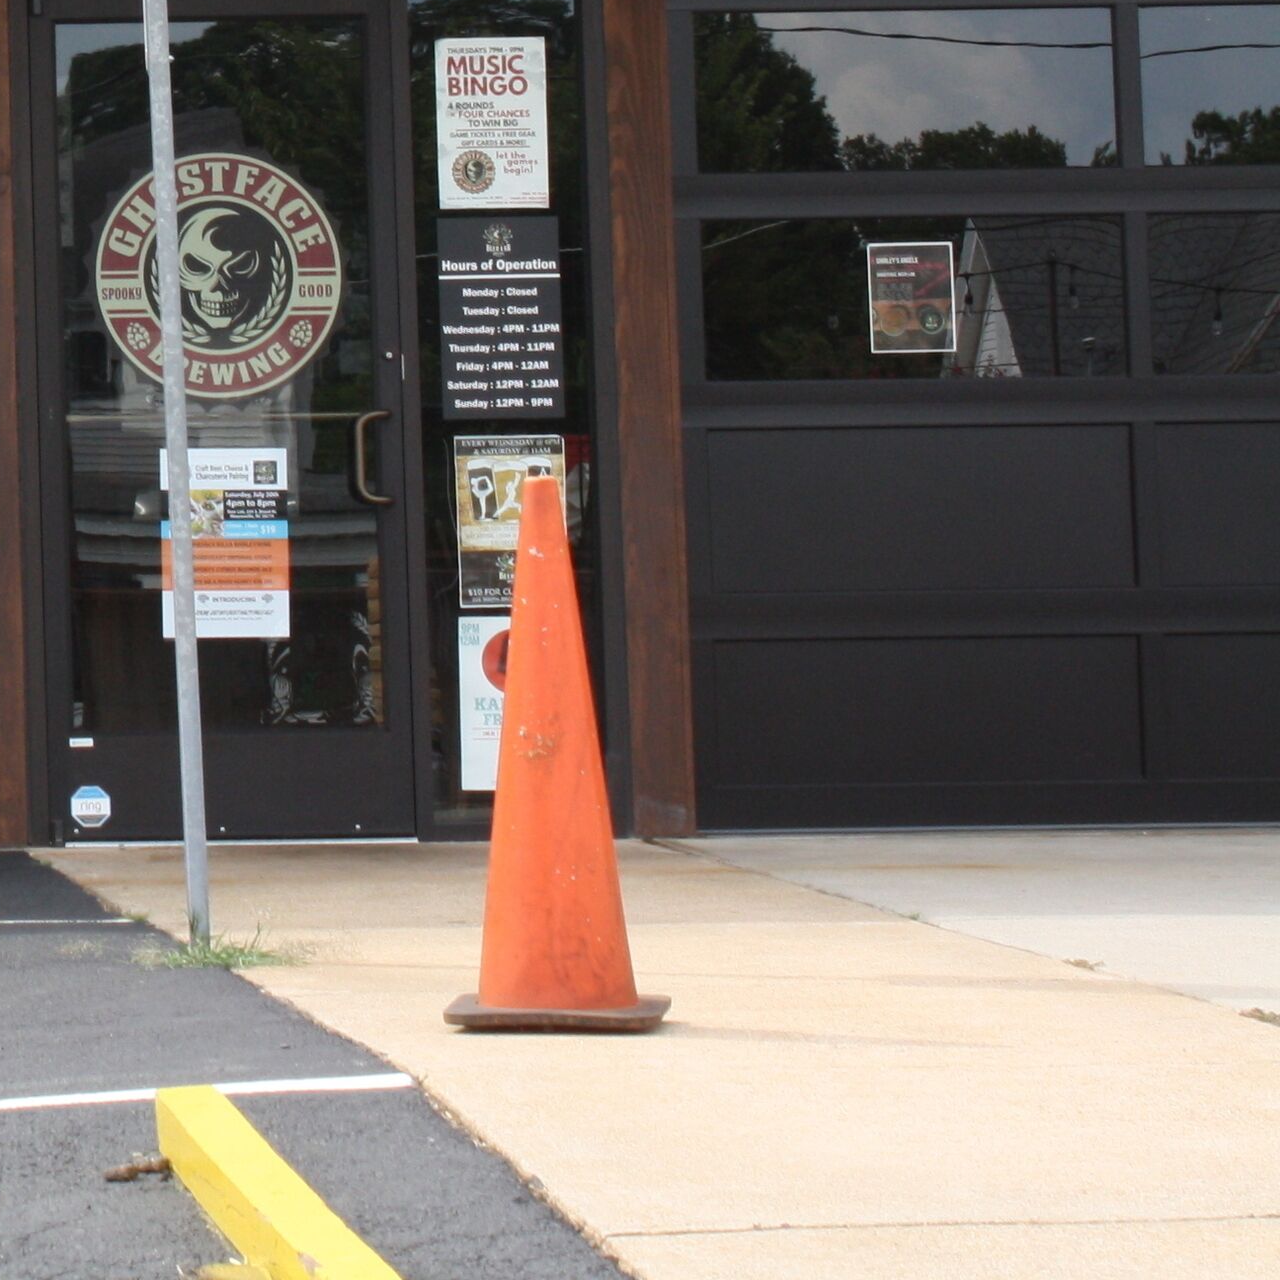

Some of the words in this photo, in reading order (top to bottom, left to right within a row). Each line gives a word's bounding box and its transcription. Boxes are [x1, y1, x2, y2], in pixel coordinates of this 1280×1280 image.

[447, 54, 524, 75] MUSIC
[448, 76, 528, 96] BINGO
[455, 102, 494, 110] ROUNDS
[458, 110, 484, 118] FOUR
[487, 109, 530, 118] CHANCES
[468, 119, 480, 127] TO
[481, 119, 500, 127] WIN
[503, 118, 519, 127] BIG
[496, 151, 508, 159] let
[510, 151, 526, 159] the
[506, 159, 538, 167] games
[108, 161, 327, 257] GHSTFACE
[441, 260, 478, 272] Hours
[481, 259, 493, 271] of
[496, 258, 557, 272] Operation
[101, 287, 142, 300] SPOOKY
[298, 284, 333, 298] GOOD
[462, 288, 499, 298] Monday
[506, 287, 538, 296] Closed
[462, 307, 500, 317] Tuesday
[507, 306, 539, 315] Closed
[442, 325, 496, 335] Wednesday
[502, 324, 524, 333] 4PM
[531, 324, 560, 333] 11PM
[449, 344, 490, 354] Thursday
[497, 343, 519, 352] 4PM
[527, 342, 555, 351] 11PM
[456, 362, 485, 372] Friday
[491, 361, 514, 370] 4PM
[521, 361, 549, 370] 12AM
[447, 381, 488, 391] Saturday
[496, 380, 524, 389] 12PM
[531, 379, 559, 388] 12AM
[454, 399, 489, 409] Sunday
[496, 399, 524, 407] 12PM
[531, 398, 553, 407] 9PM
[226, 499, 245, 507] 4pm
[247, 499, 256, 507] to
[484, 588, 501, 596] FOR
[80, 801, 102, 812] ring
